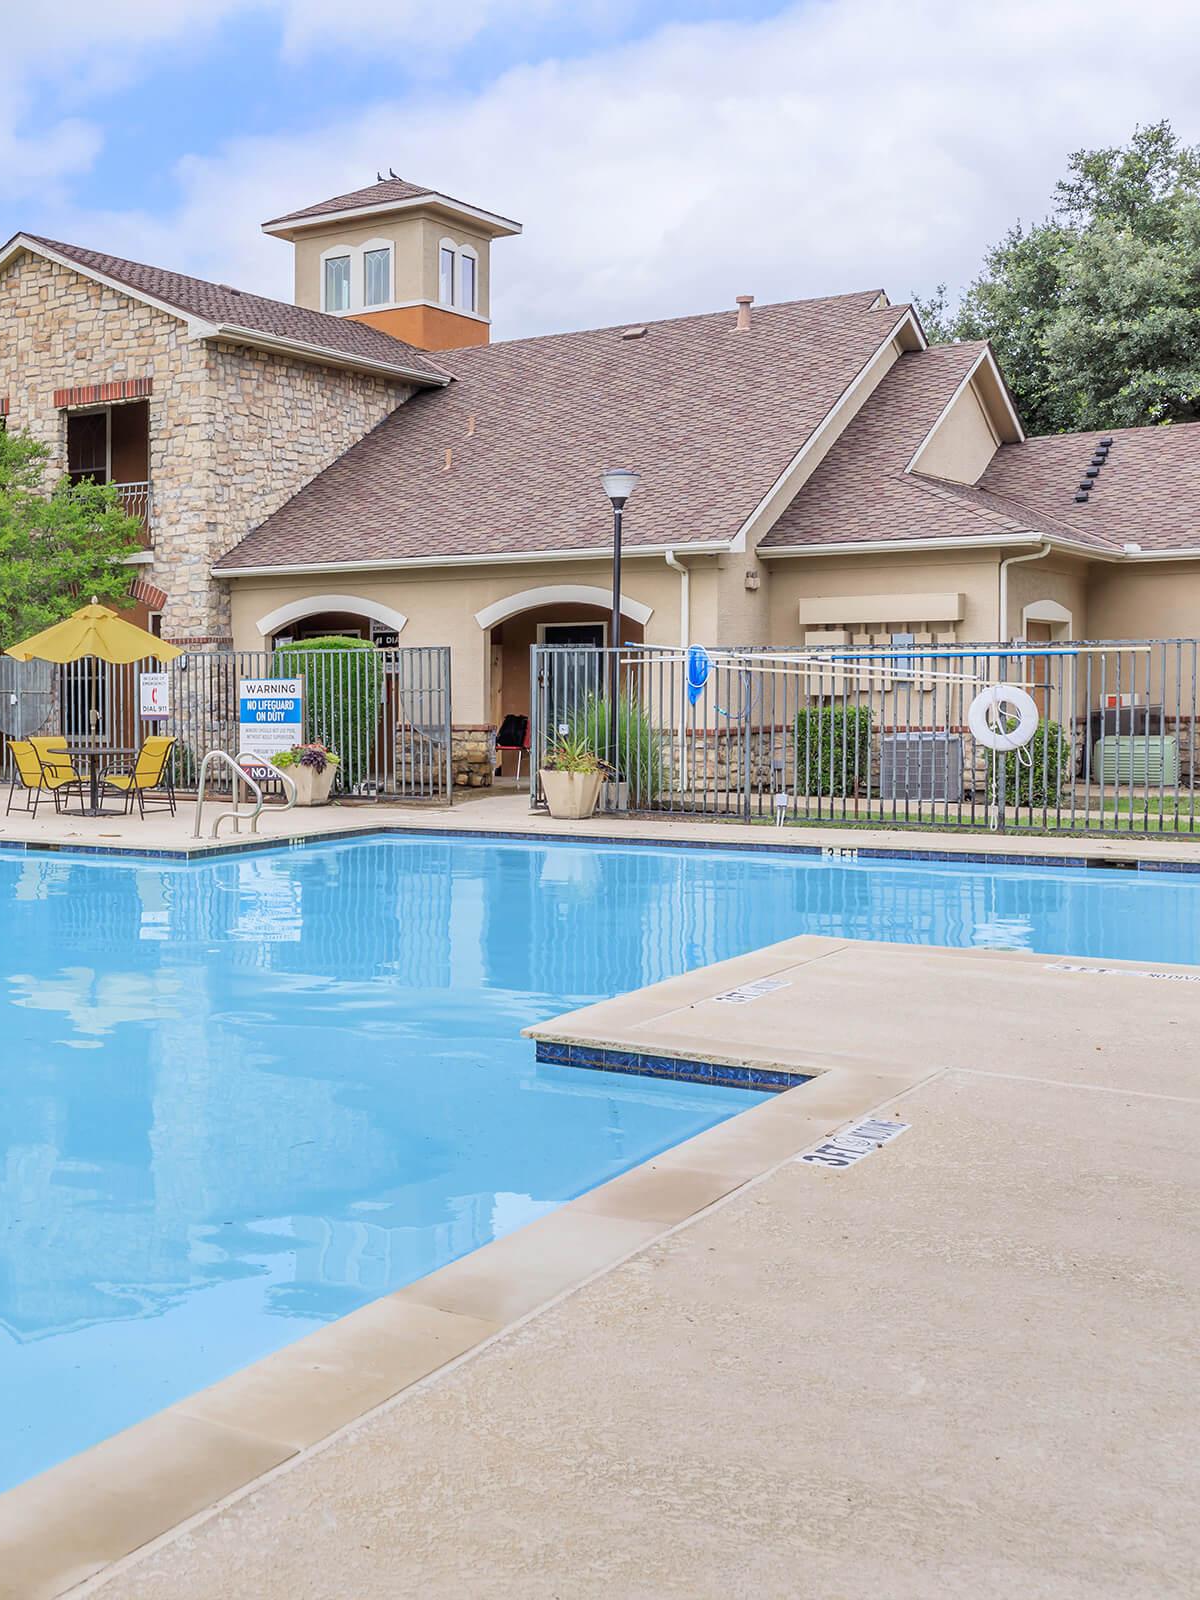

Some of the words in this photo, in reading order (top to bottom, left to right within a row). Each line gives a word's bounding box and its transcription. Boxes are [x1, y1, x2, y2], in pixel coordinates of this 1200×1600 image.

[246, 684, 296, 694] WARNING
[246, 699, 257, 710] NO
[258, 699, 295, 711] LIFEGUARD
[256, 711, 266, 721] ON
[267, 711, 285, 721] DUTY
[251, 767, 266, 778] NO
[802, 1155, 850, 1166] 3
